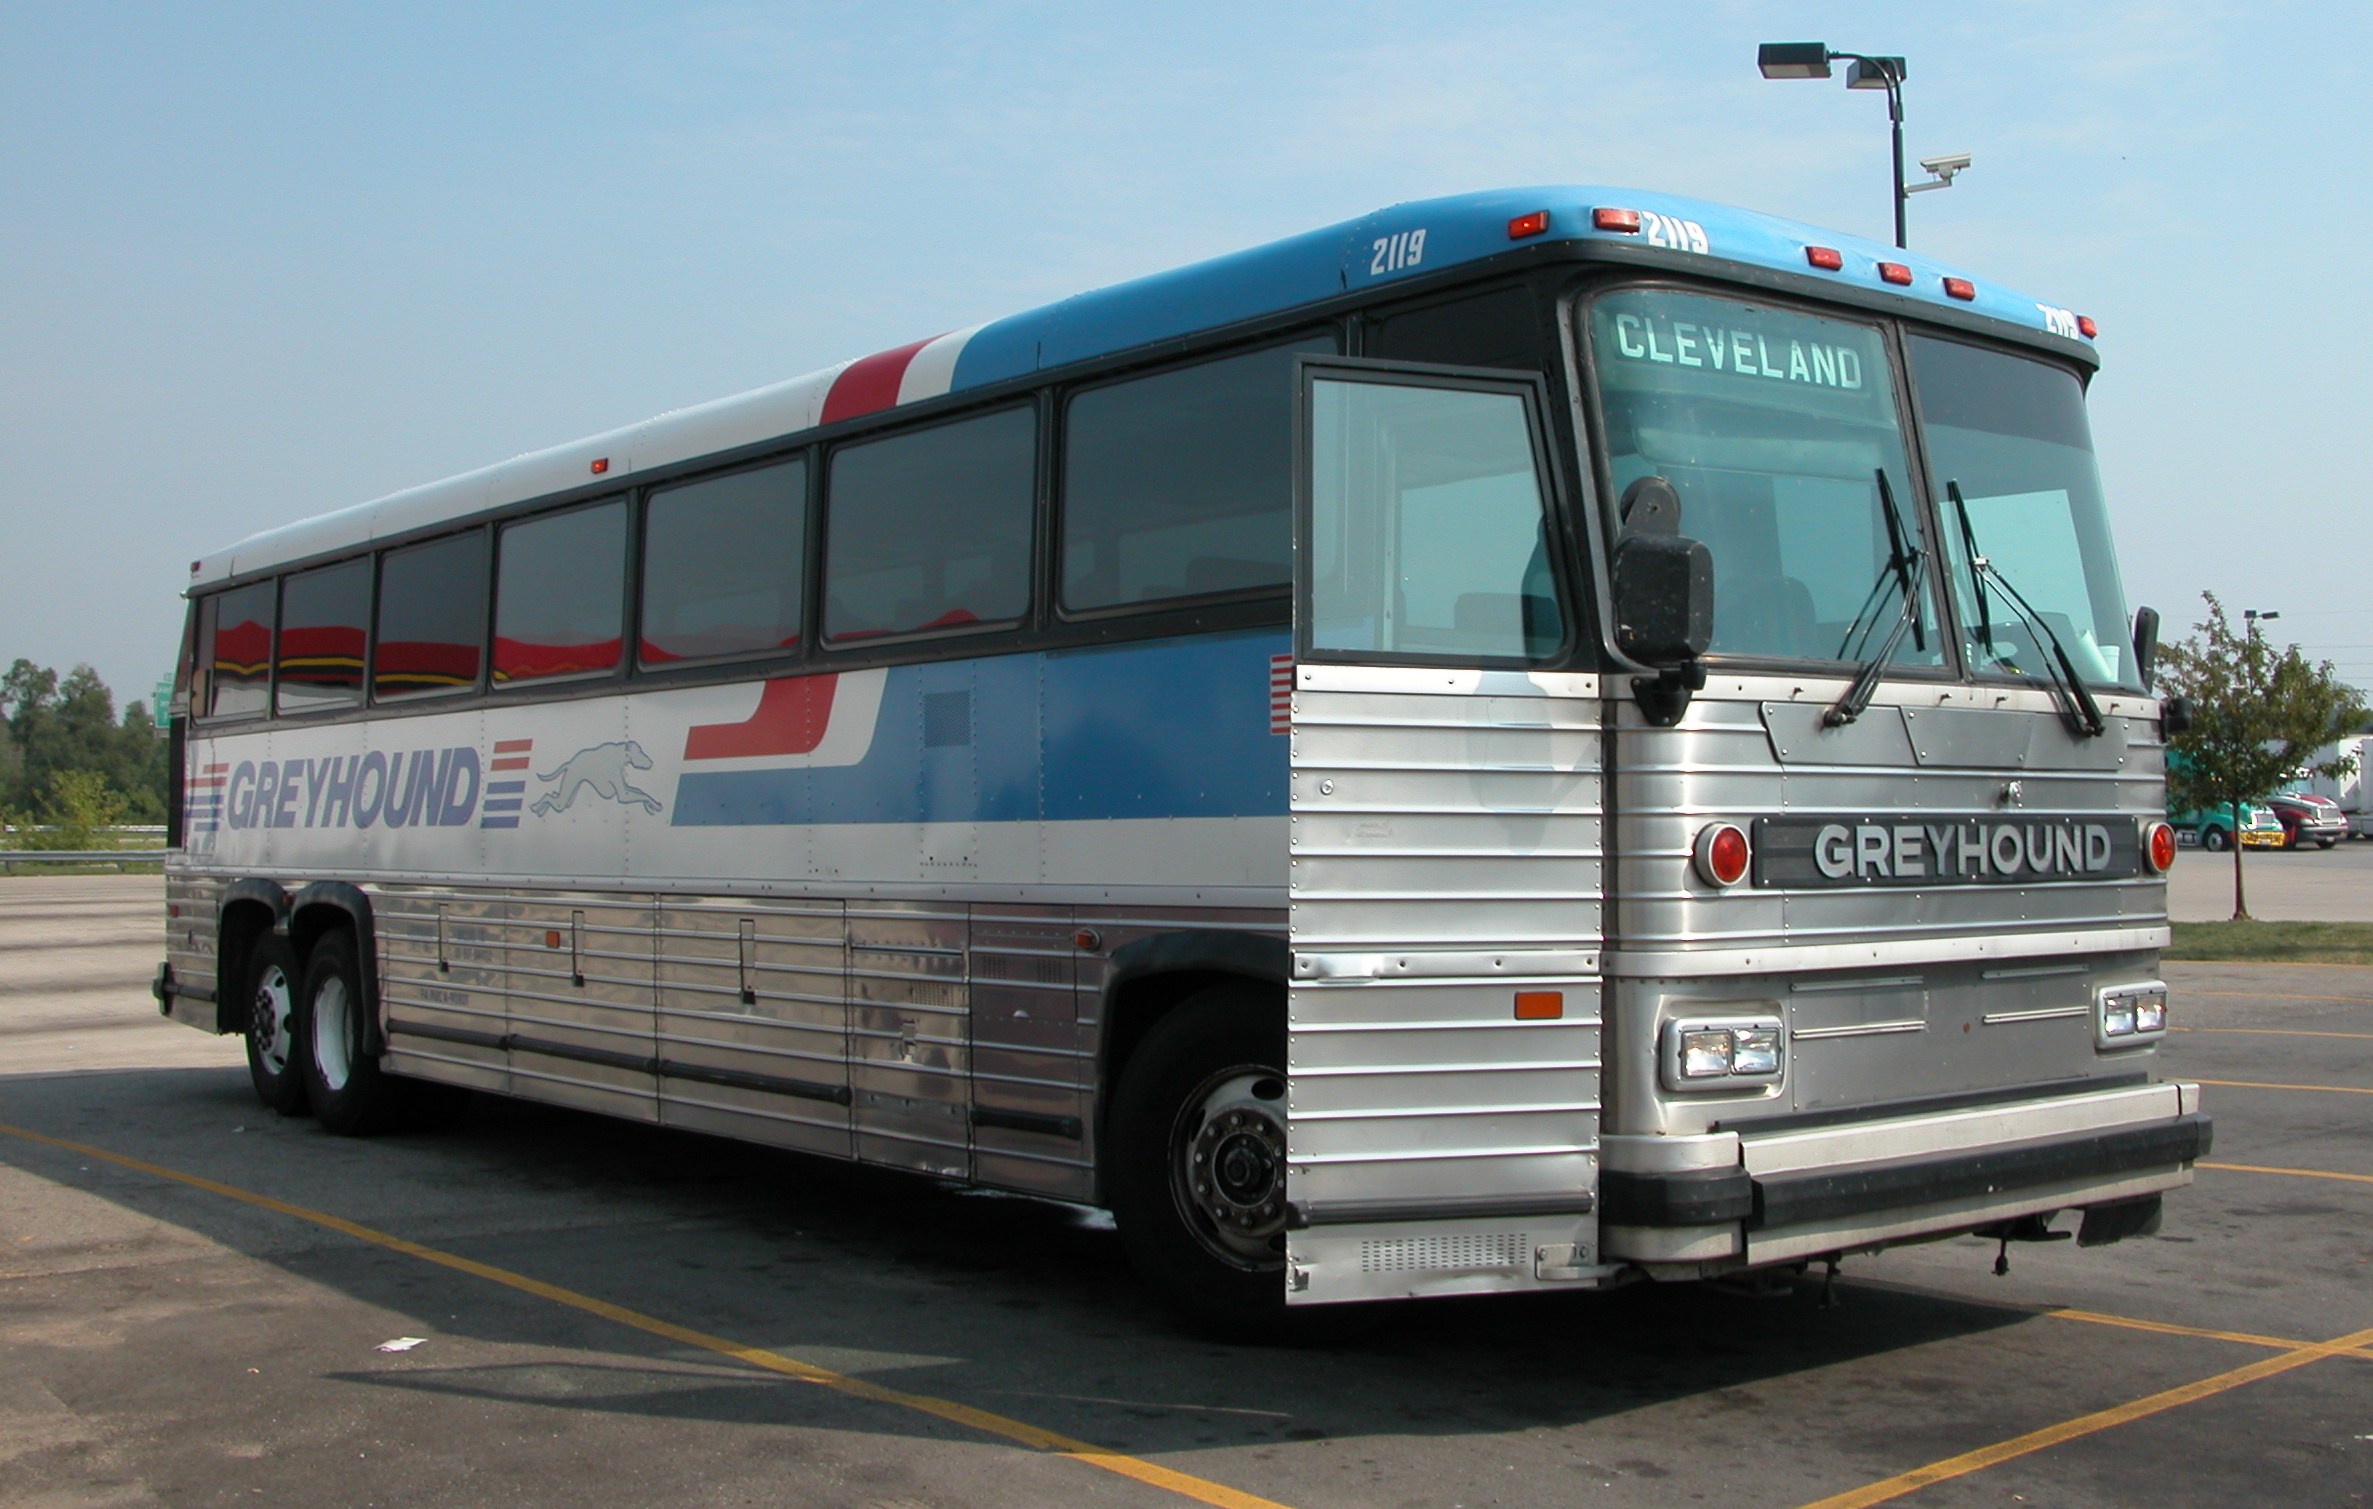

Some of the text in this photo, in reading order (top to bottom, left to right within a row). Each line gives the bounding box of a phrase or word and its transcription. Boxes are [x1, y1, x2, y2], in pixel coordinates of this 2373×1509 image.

[1371, 229, 1426, 276] 2119
[1642, 210, 1709, 255] 2119
[1614, 312, 1861, 390] CLEVELAND
[228, 746, 482, 830] GREYHOUND
[1814, 823, 2112, 879] GREYHOUND
